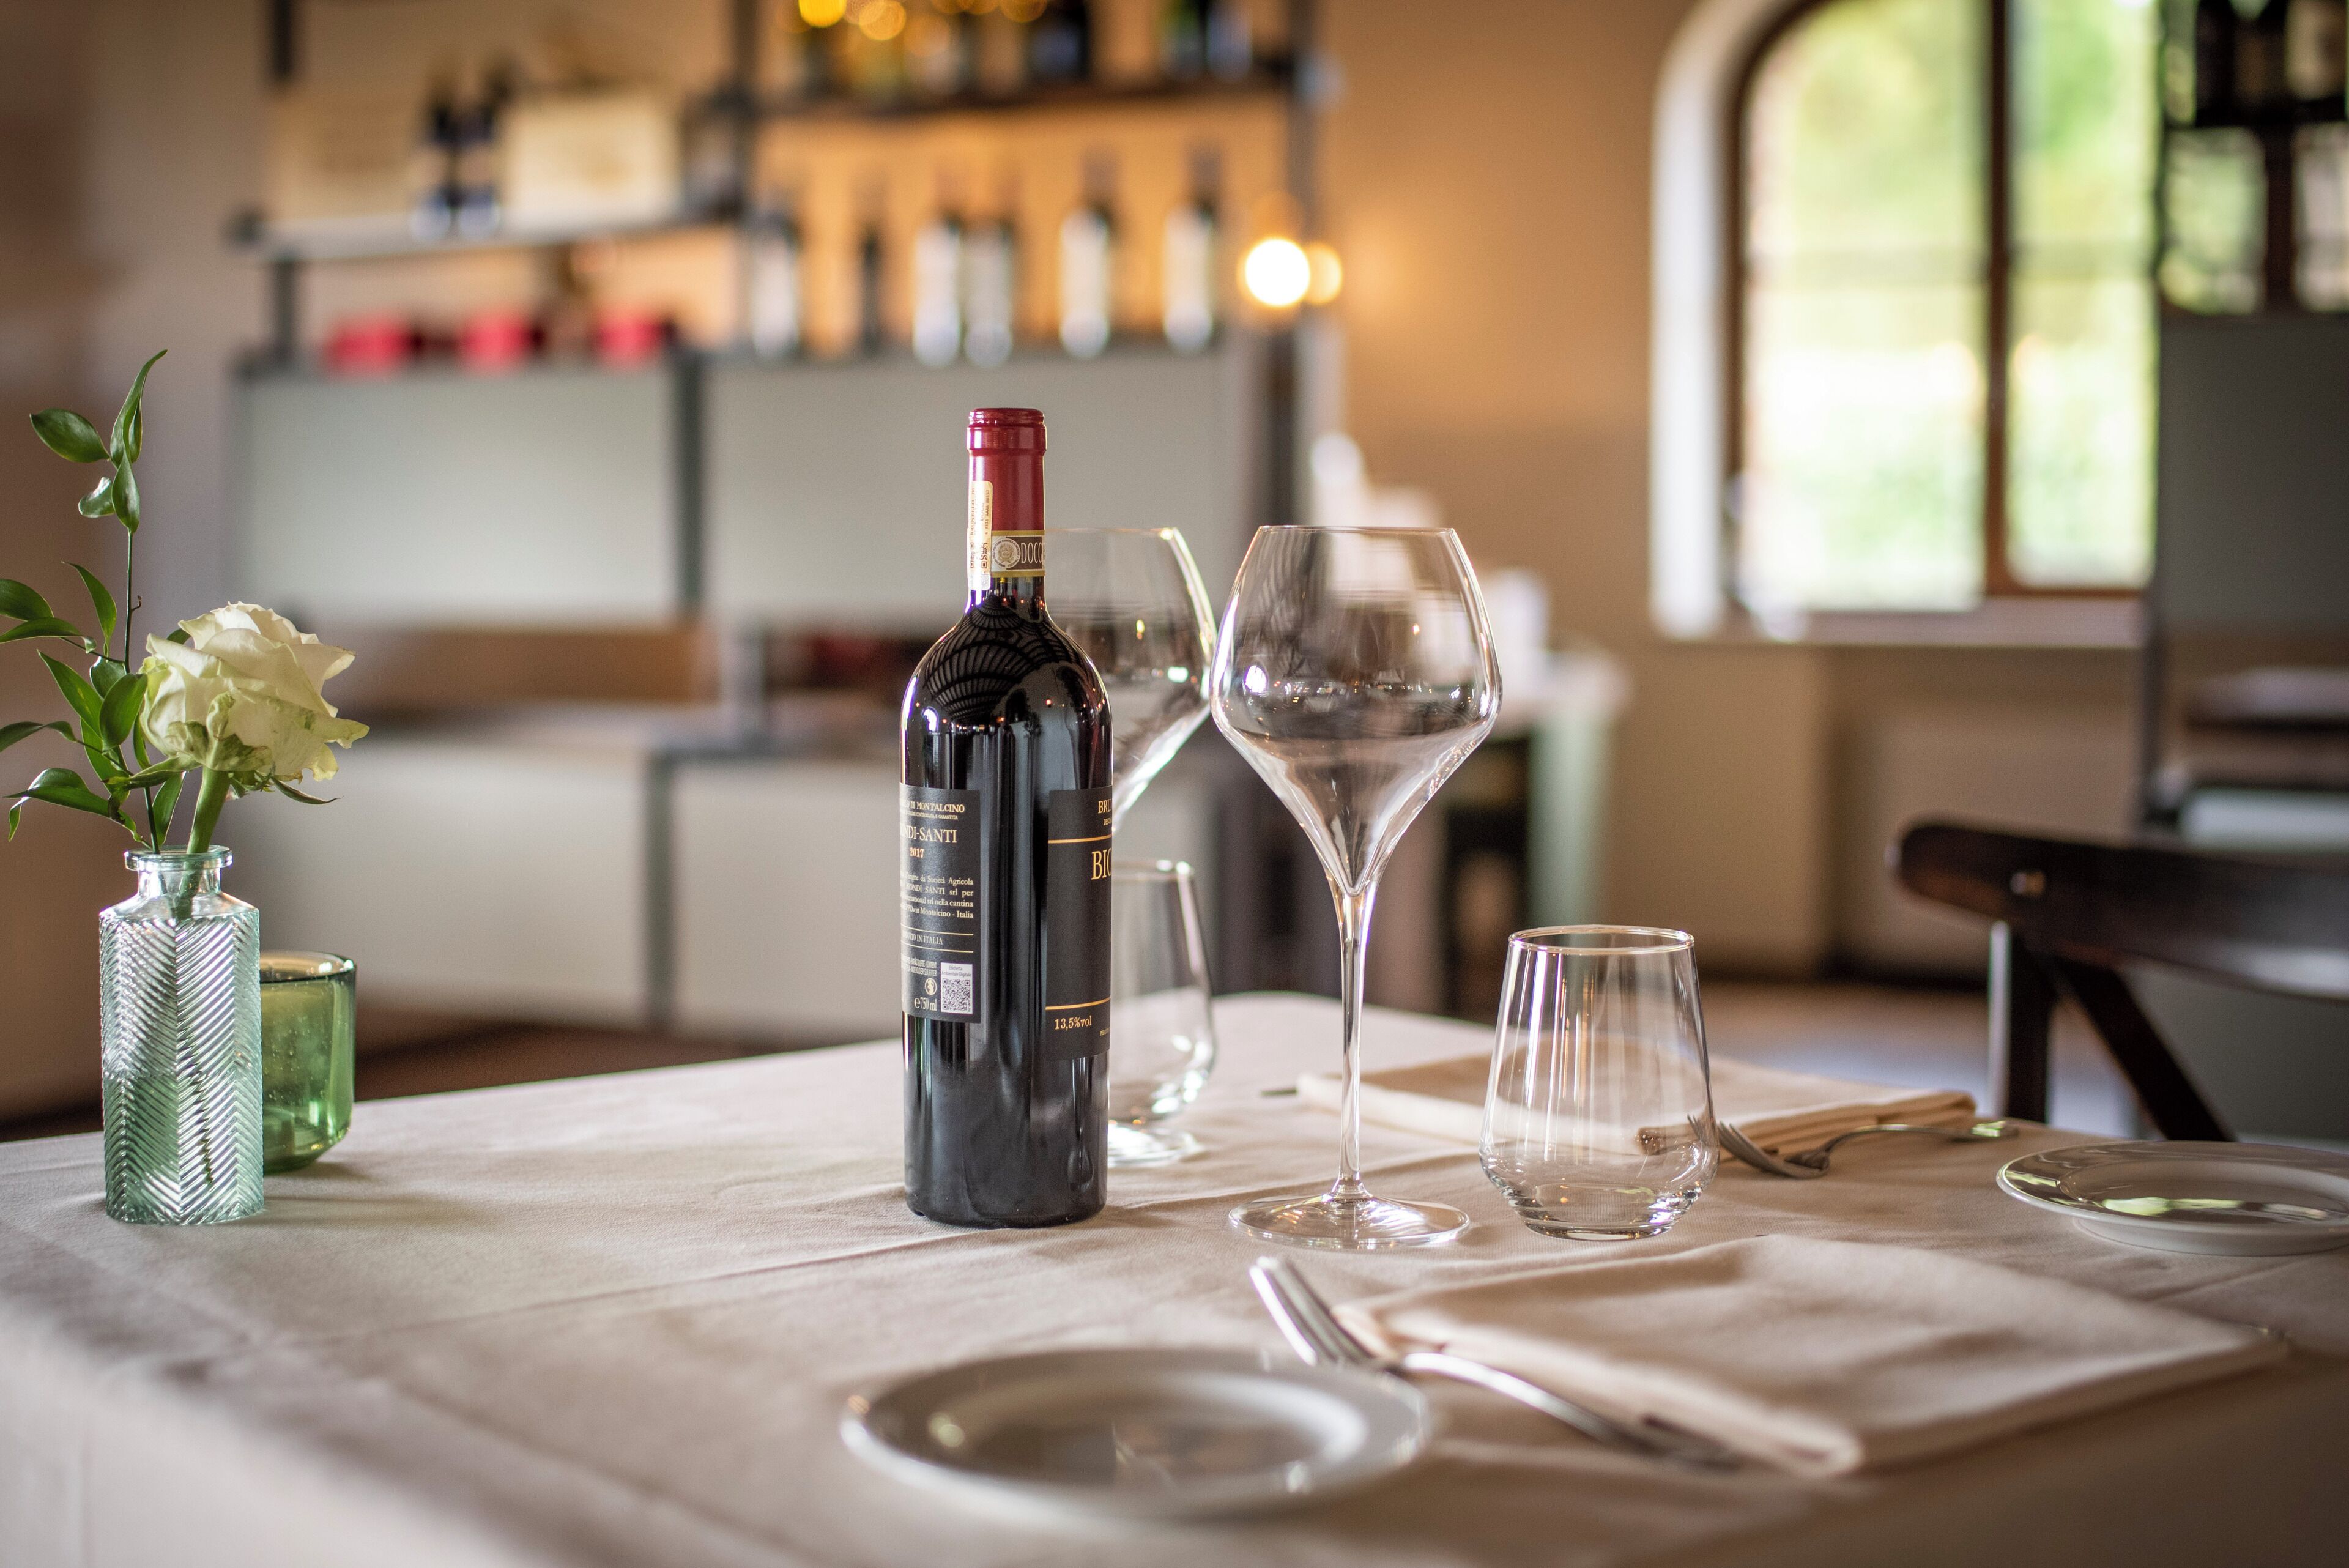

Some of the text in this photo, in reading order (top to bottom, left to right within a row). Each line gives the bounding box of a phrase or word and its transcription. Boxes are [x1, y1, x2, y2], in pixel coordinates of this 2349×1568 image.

[916, 801, 965, 813] MONTALCINO
[910, 847, 924, 858] 2017
[948, 877, 973, 886] Agricola
[924, 885, 945, 894] SANTI
[920, 907, 951, 917] Montalcino
[923, 935, 943, 945] ITALIA
[930, 998, 937, 1011] ml
[1055, 1016, 1092, 1031] 13,5%vol
